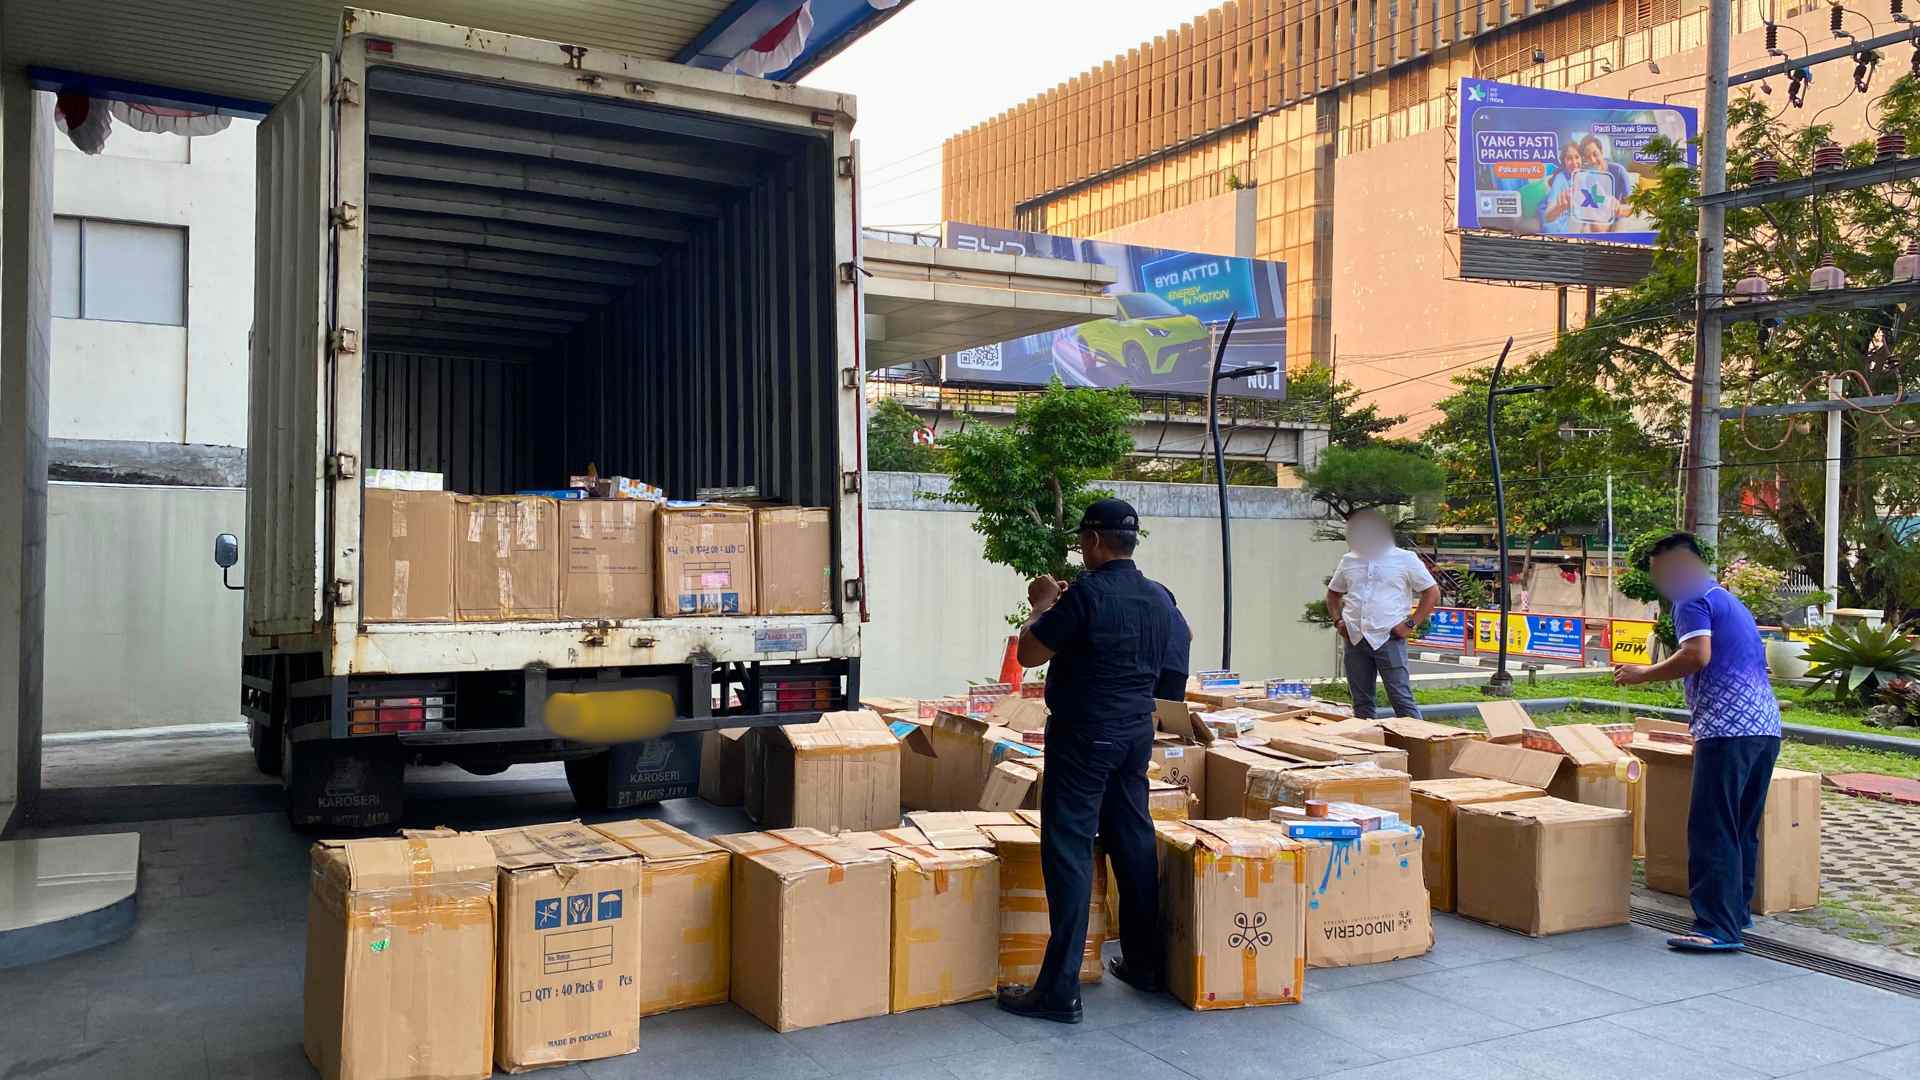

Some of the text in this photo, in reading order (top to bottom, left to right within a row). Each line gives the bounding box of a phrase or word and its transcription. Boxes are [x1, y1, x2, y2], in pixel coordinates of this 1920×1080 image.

[1611, 125, 1636, 135] Banyak
[1636, 125, 1657, 133] Bonus
[1480, 136, 1553, 148] YANG PASTI
[1480, 149, 1556, 160] PRAKTIS AJA
[1155, 259, 1231, 288] BYD ATTO 1
[1168, 287, 1201, 299] ENERGY
[1196, 289, 1230, 304] MOTION
[630, 770, 680, 784] KAROSERI
[317, 794, 382, 809] KAROSERI
[1323, 921, 1396, 941] INDOCERIA
[535, 987, 552, 1002] QTY
[561, 983, 572, 996] 40
[575, 980, 595, 994] Pack
[619, 975, 632, 987] Pcs
[548, 1038, 567, 1048] MADE
[578, 1030, 613, 1043] INDONESIA
